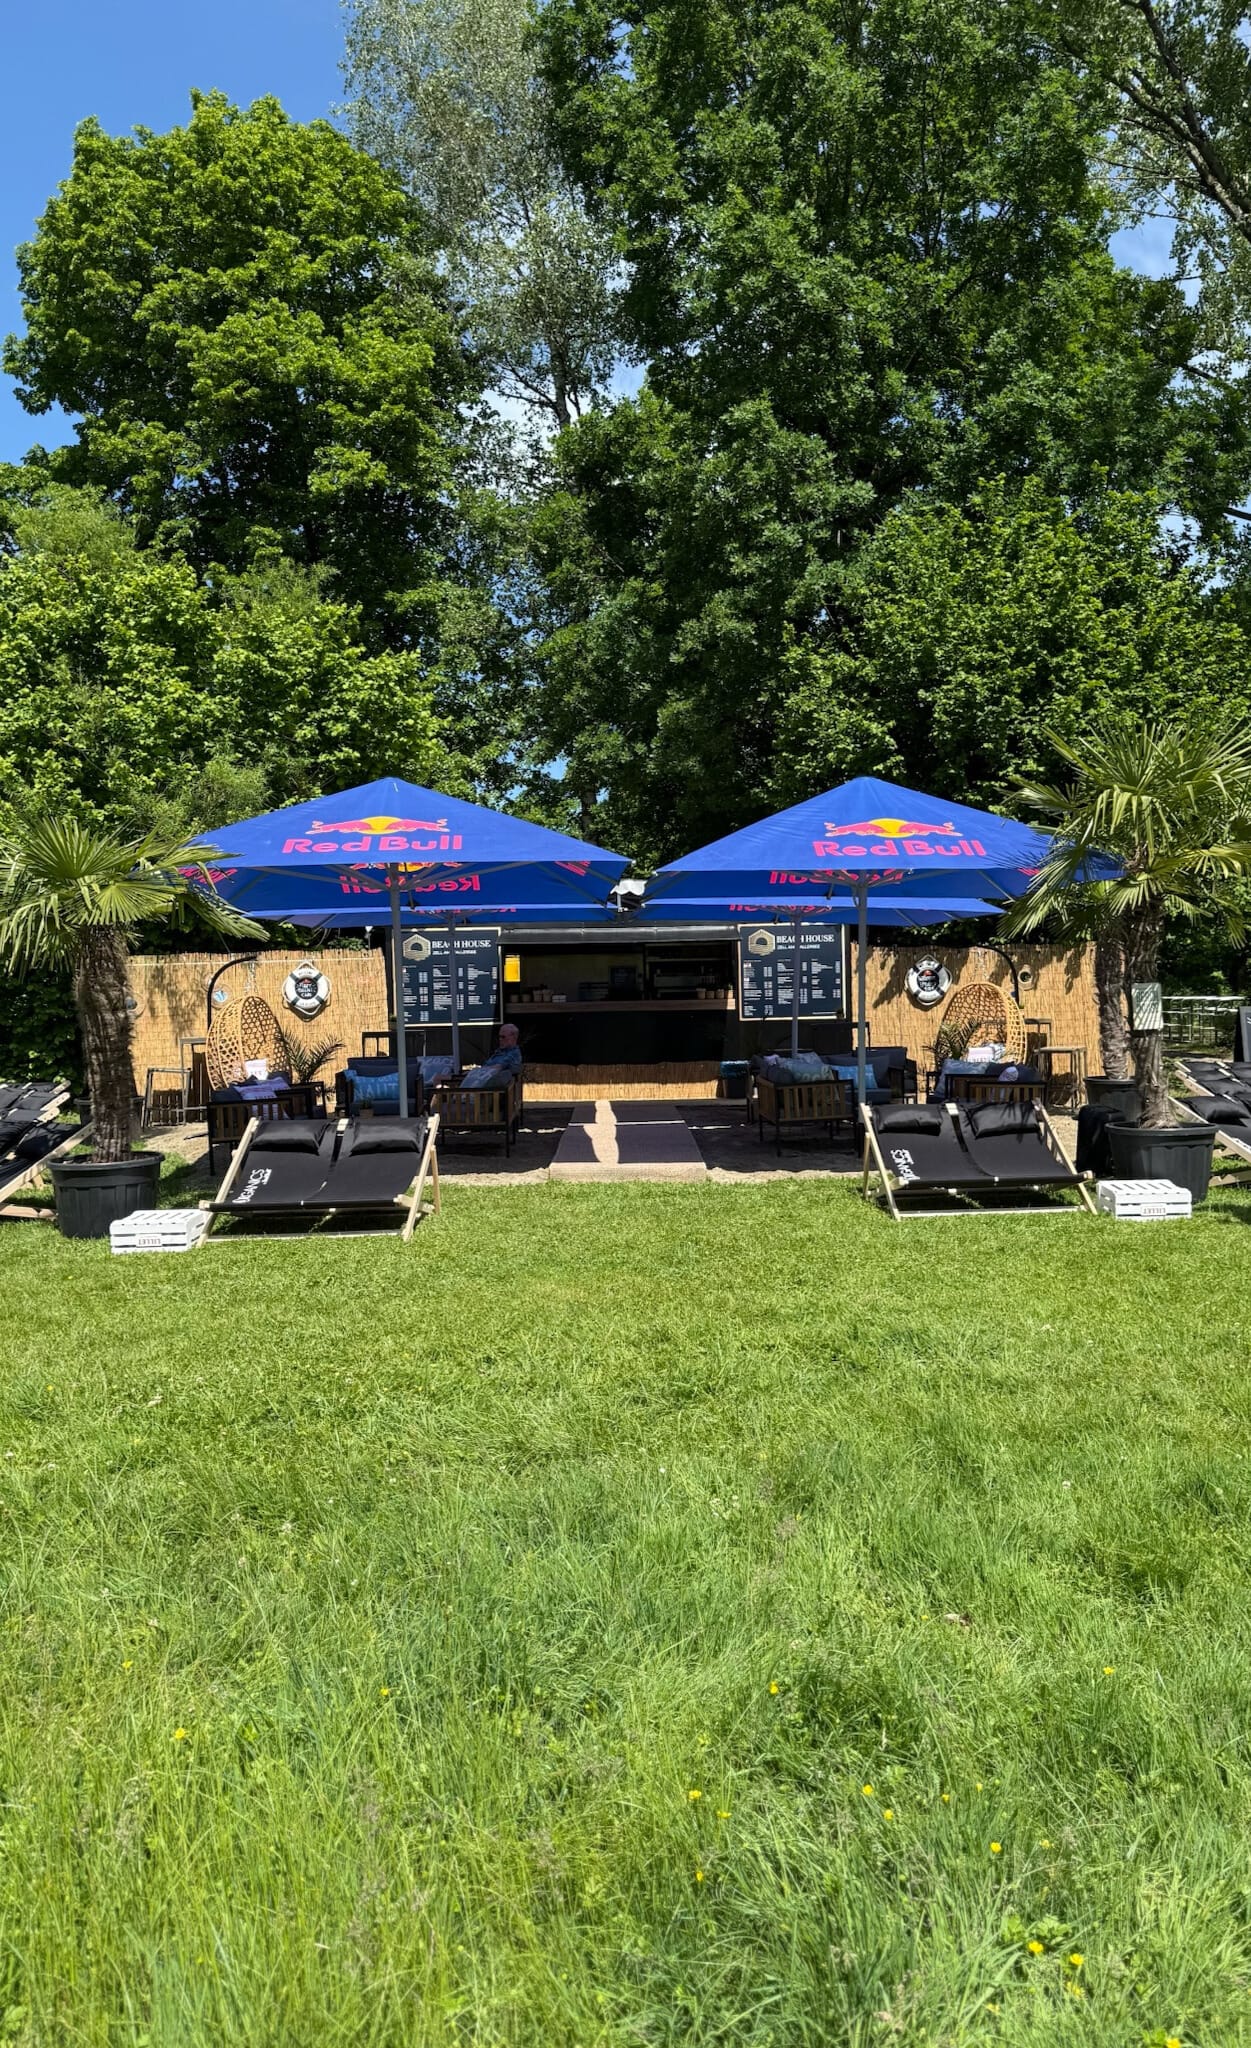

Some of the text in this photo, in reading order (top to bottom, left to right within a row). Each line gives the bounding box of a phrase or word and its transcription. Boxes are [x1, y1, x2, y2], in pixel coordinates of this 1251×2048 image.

[282, 835, 463, 853] Red Bull
[812, 840, 987, 857] Red Bull
[432, 939, 492, 949] BEAH HOUSE
[806, 934, 835, 943] HOUSE
